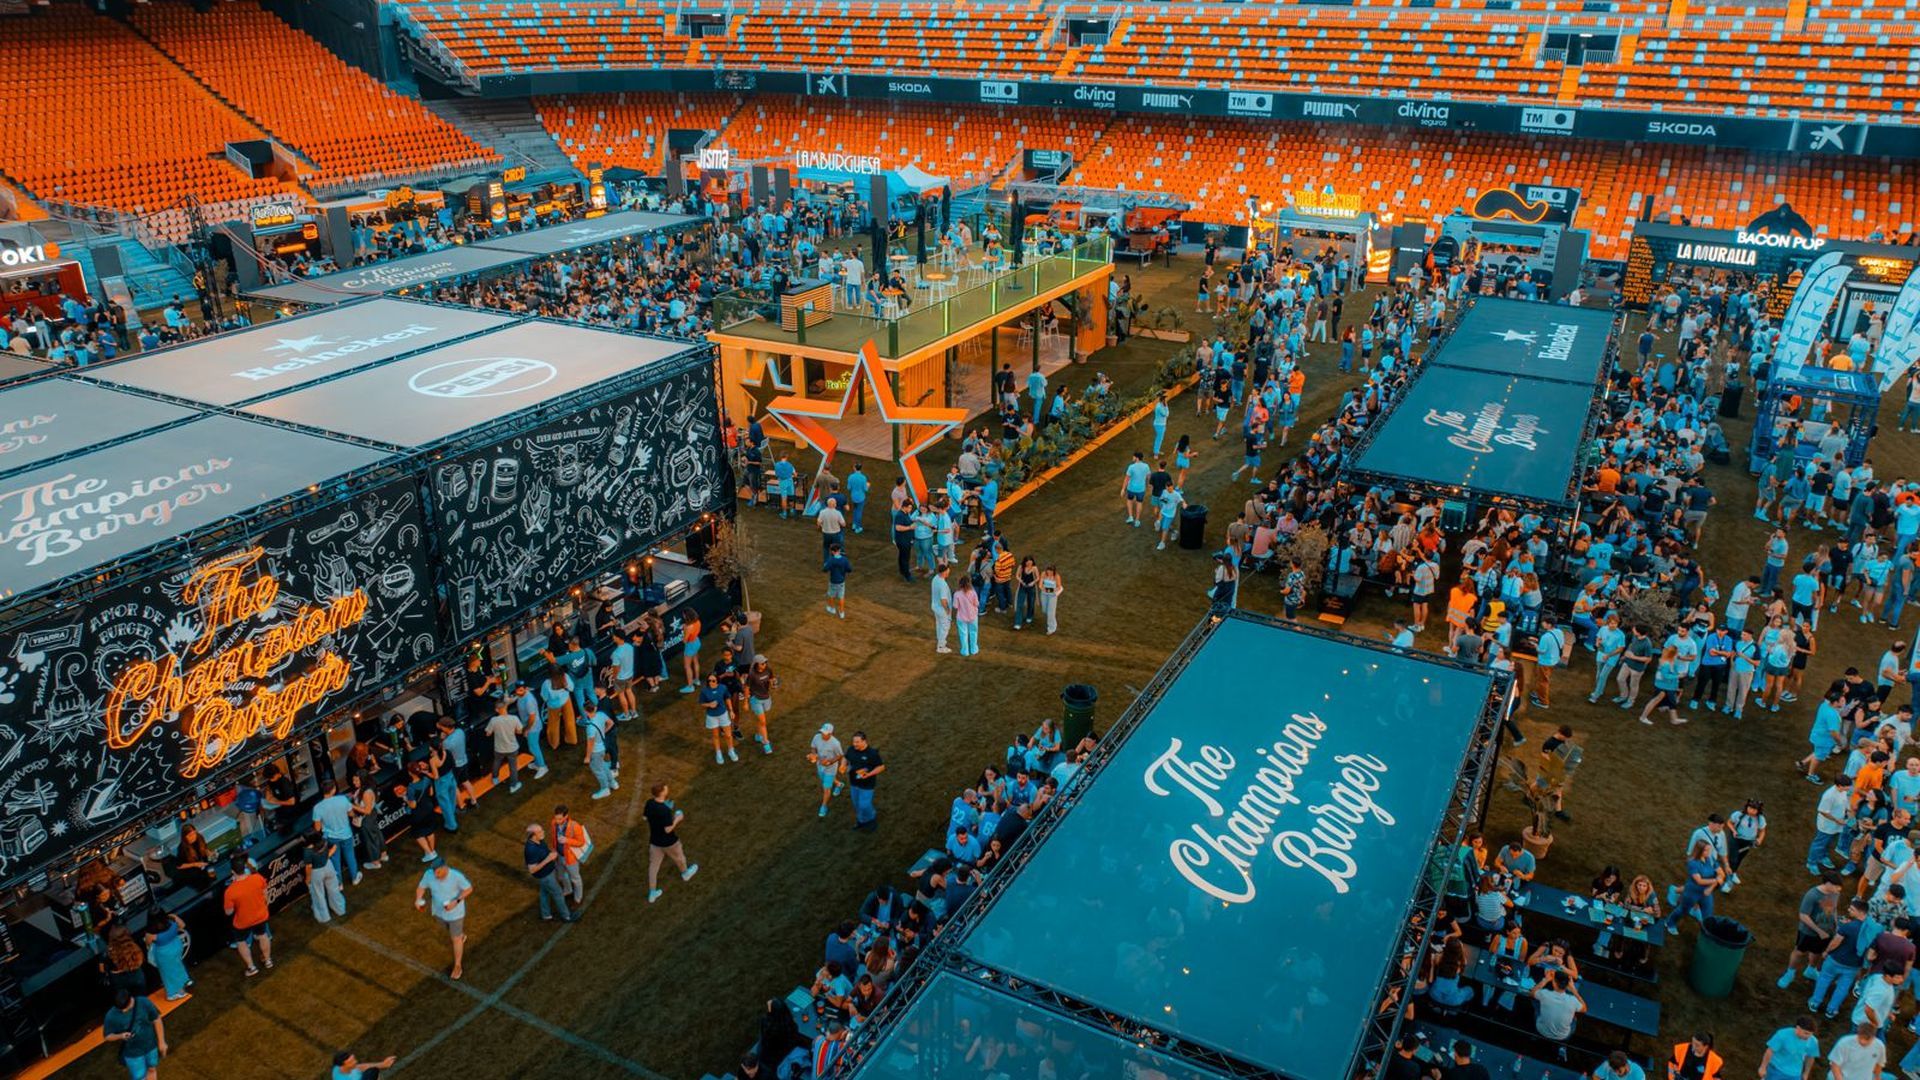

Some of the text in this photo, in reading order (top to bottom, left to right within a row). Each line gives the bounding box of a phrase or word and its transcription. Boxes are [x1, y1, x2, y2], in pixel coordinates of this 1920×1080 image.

[983, 85, 996, 94] TM
[1073, 86, 1116, 101] divina
[1142, 92, 1180, 108] PUMA
[1231, 96, 1247, 107] TM
[1303, 101, 1345, 118] PUMA
[1397, 102, 1450, 120] divina
[1420, 119, 1448, 127] seguros
[1525, 112, 1544, 124] TM
[1736, 231, 1792, 249] BACON
[1, 245, 46, 266] OKI
[1676, 243, 1757, 266] LA MURALLA
[230, 323, 438, 381] Heineken
[428, 359, 539, 394] PEPSI
[1423, 407, 1468, 432] The
[0, 473, 108, 522] The
[0, 456, 233, 545] ampions
[16, 482, 232, 567] Burger
[547, 546, 573, 576] COOL
[184, 546, 280, 654] The
[90, 602, 166, 633] AMOR DE
[98, 621, 154, 645] BURGER
[105, 588, 369, 749] Champions
[180, 651, 352, 779] Burger
[1144, 736, 1237, 817] The
[1169, 711, 1328, 904] Champions
[1272, 752, 1396, 894] Burger
[268, 853, 290, 880] The
